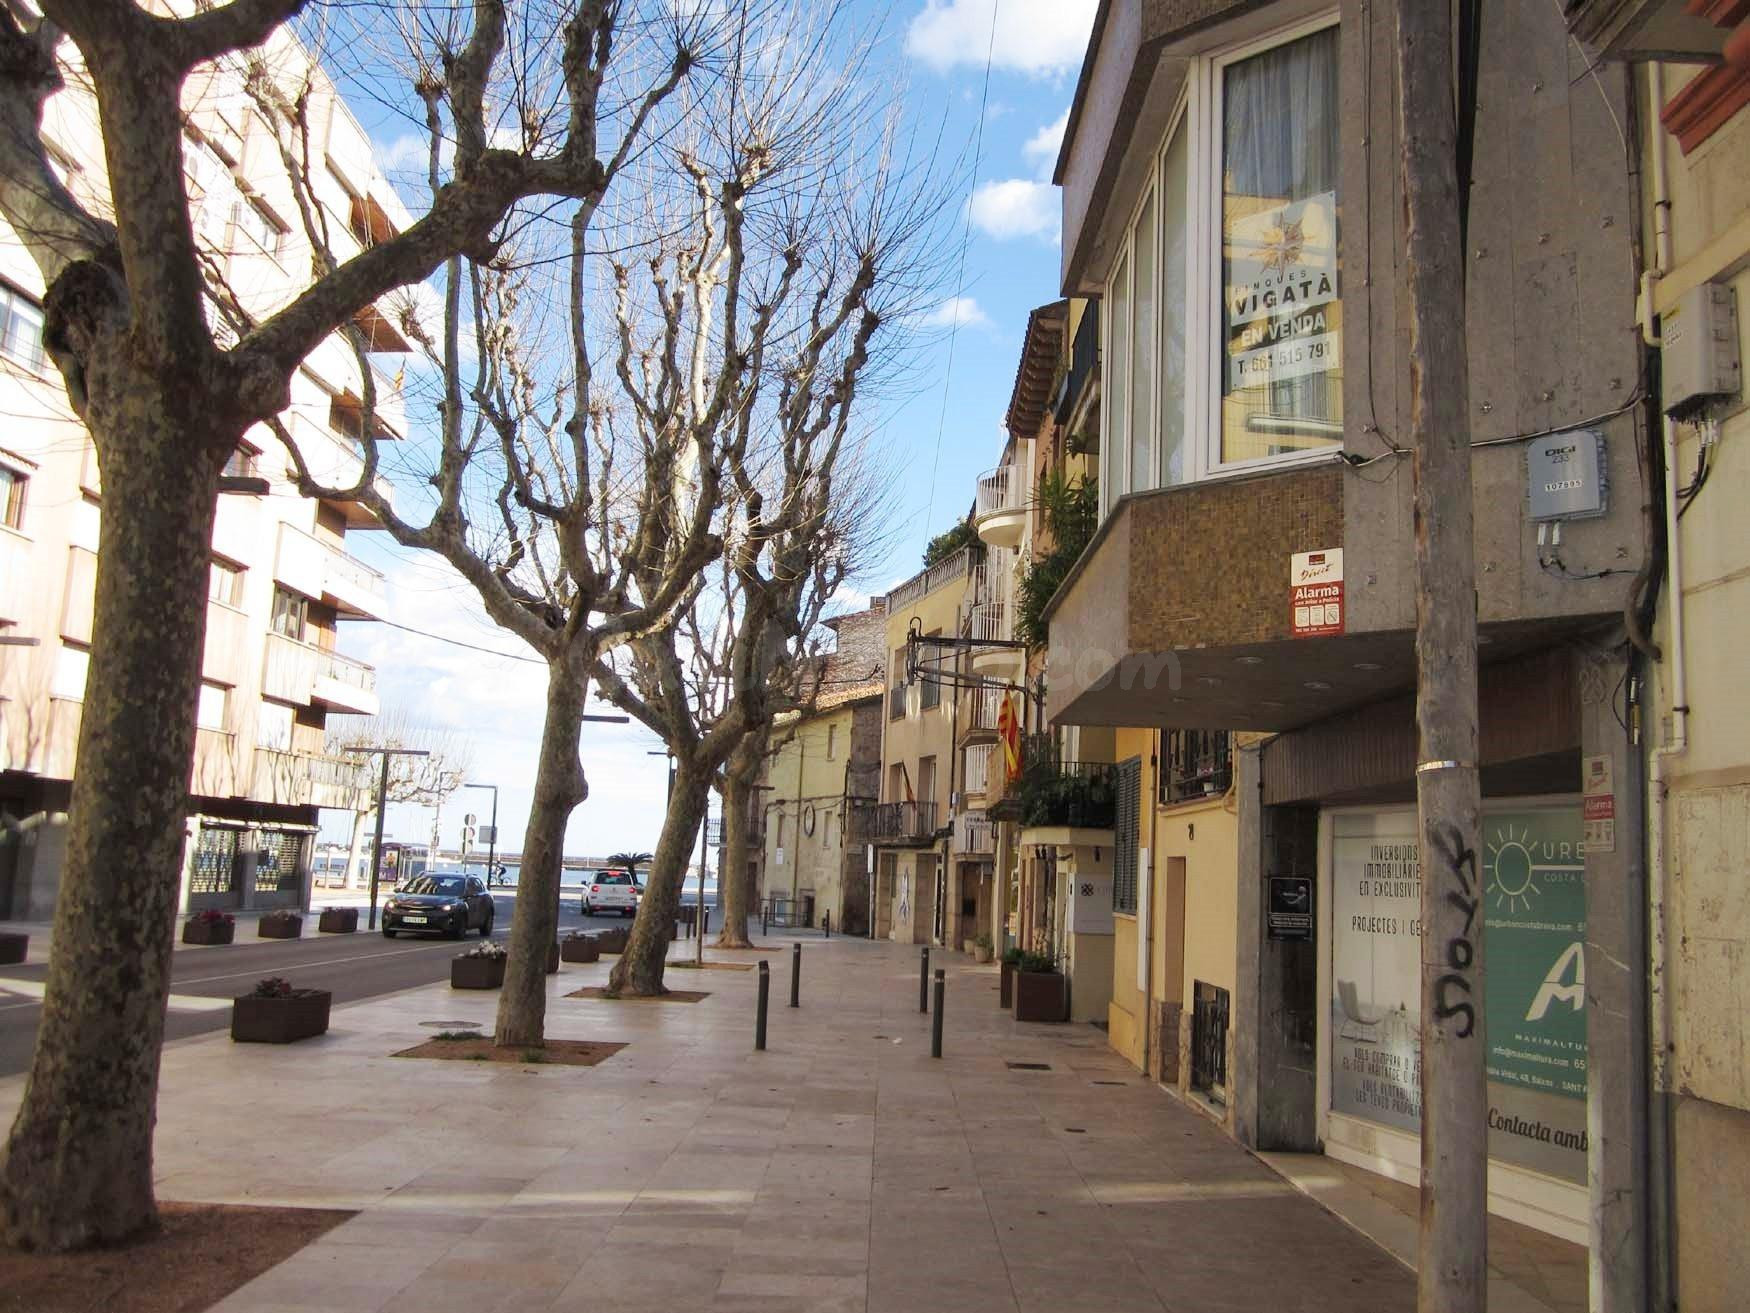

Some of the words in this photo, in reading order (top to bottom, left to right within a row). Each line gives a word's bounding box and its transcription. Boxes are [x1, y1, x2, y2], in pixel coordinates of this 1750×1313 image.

[1235, 272, 1332, 316] VIGATÀ
[1241, 327, 1263, 346] EN
[1268, 311, 1326, 340] VENDA
[1295, 586, 1339, 600] Alarma
[1371, 845, 1418, 861] INVERSIONS
[1543, 872, 1576, 883] COSTA
[1359, 881, 1369, 896] EN
[1352, 915, 1397, 935] PROJECTES
[1488, 1107, 1550, 1143] Contacta
[1555, 1129, 1588, 1152] amb
